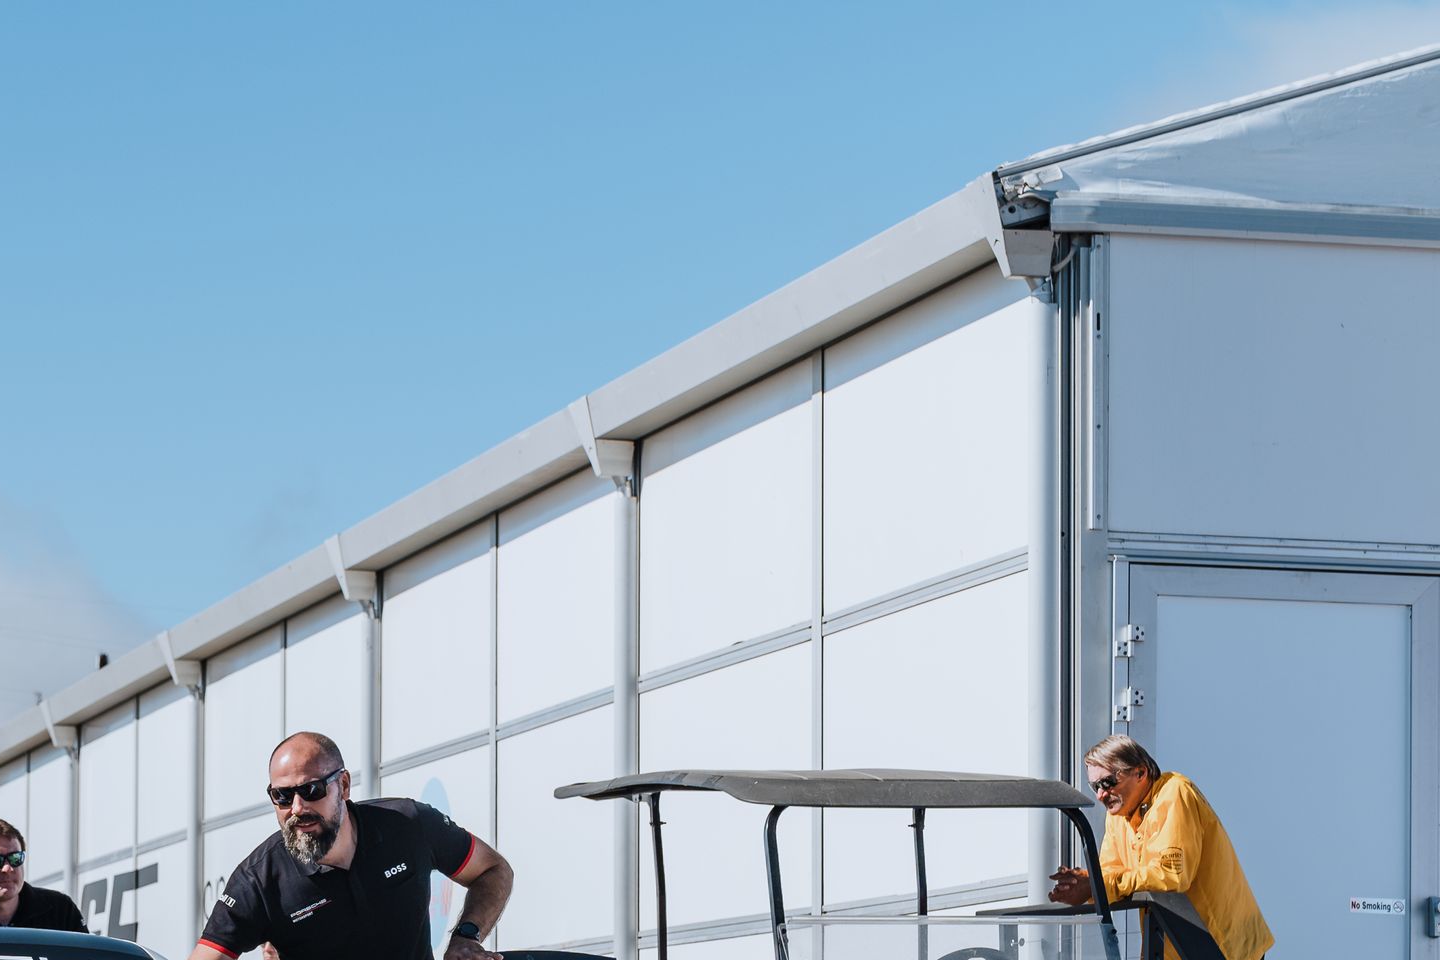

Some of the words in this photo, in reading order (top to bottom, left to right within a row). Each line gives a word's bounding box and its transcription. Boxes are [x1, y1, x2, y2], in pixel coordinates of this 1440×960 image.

[384, 863, 407, 878] BOSS
[1351, 900, 1360, 909] No
[1362, 901, 1391, 912] Smoking
